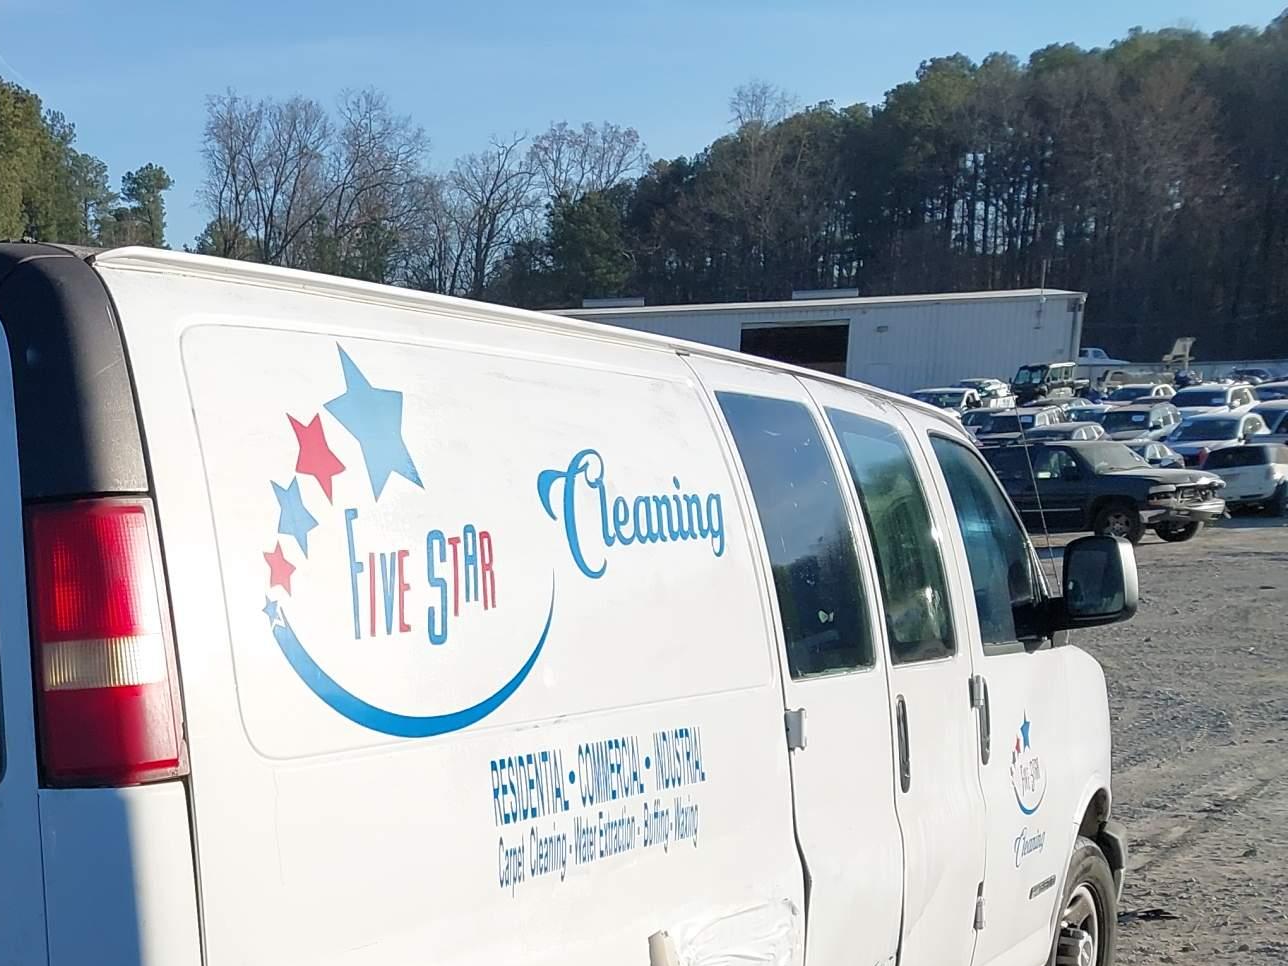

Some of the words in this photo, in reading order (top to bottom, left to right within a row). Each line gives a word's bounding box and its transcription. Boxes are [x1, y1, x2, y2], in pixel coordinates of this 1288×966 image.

[537, 449, 725, 579] Cleaning
[490, 749, 569, 827] RESIDENTIAL
[578, 736, 644, 807] COMMERCIAL
[653, 726, 705, 791] INDUSTRIAL
[498, 834, 525, 899] Carpet
[530, 821, 567, 882] Cleaning
[574, 816, 597, 865] Water
[599, 805, 635, 858] Extraction
[644, 799, 669, 853] Buffing
[674, 794, 698, 848] Waxing
